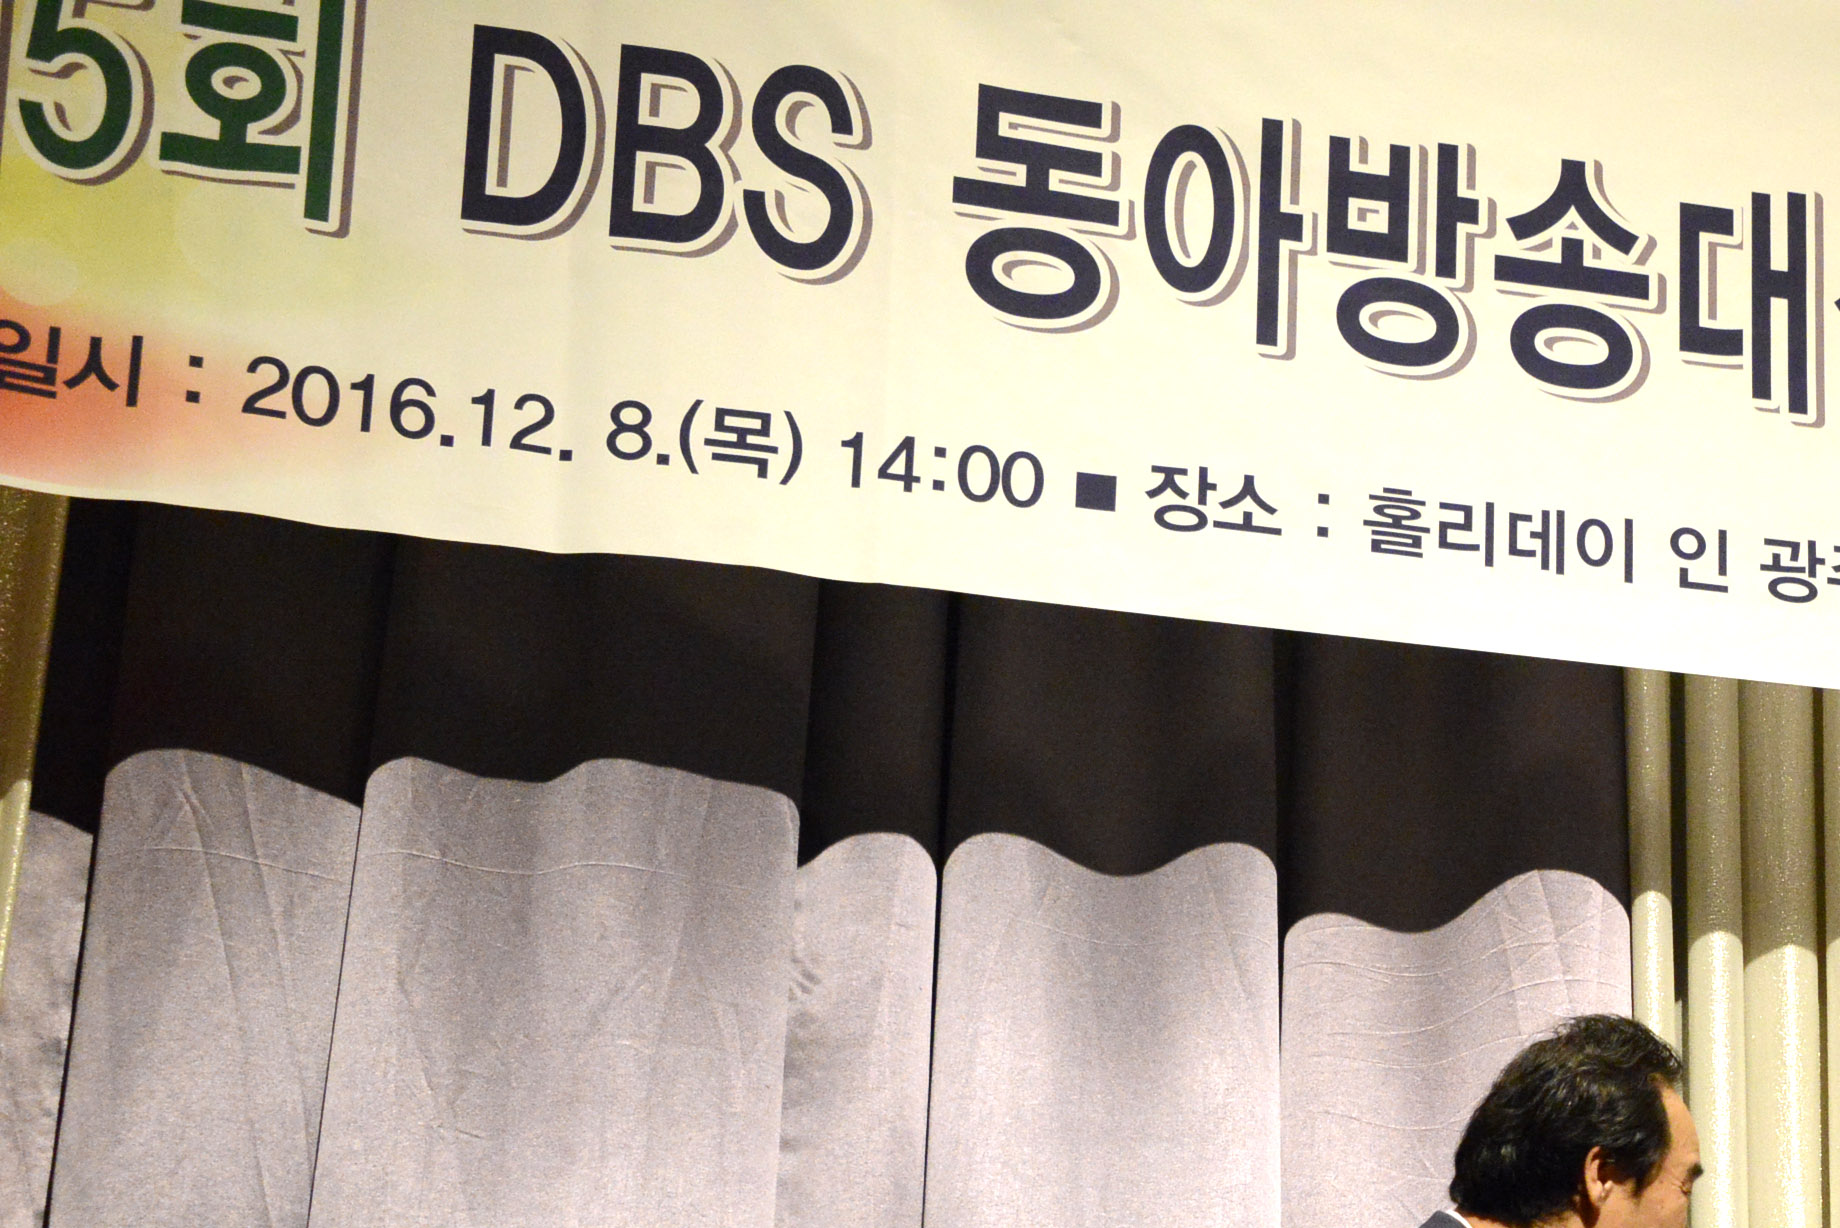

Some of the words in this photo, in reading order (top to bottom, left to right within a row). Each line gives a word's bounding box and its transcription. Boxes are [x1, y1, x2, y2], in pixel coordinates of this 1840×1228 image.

[460, 24, 853, 270] DBS
[0, 318, 144, 408] 일시
[606, 399, 802, 485] 8.(목)
[841, 432, 1044, 508] 14:00
[1145, 465, 1282, 535] 장소
[1363, 487, 1633, 583] 홀리데이
[1670, 527, 1728, 592] 인
